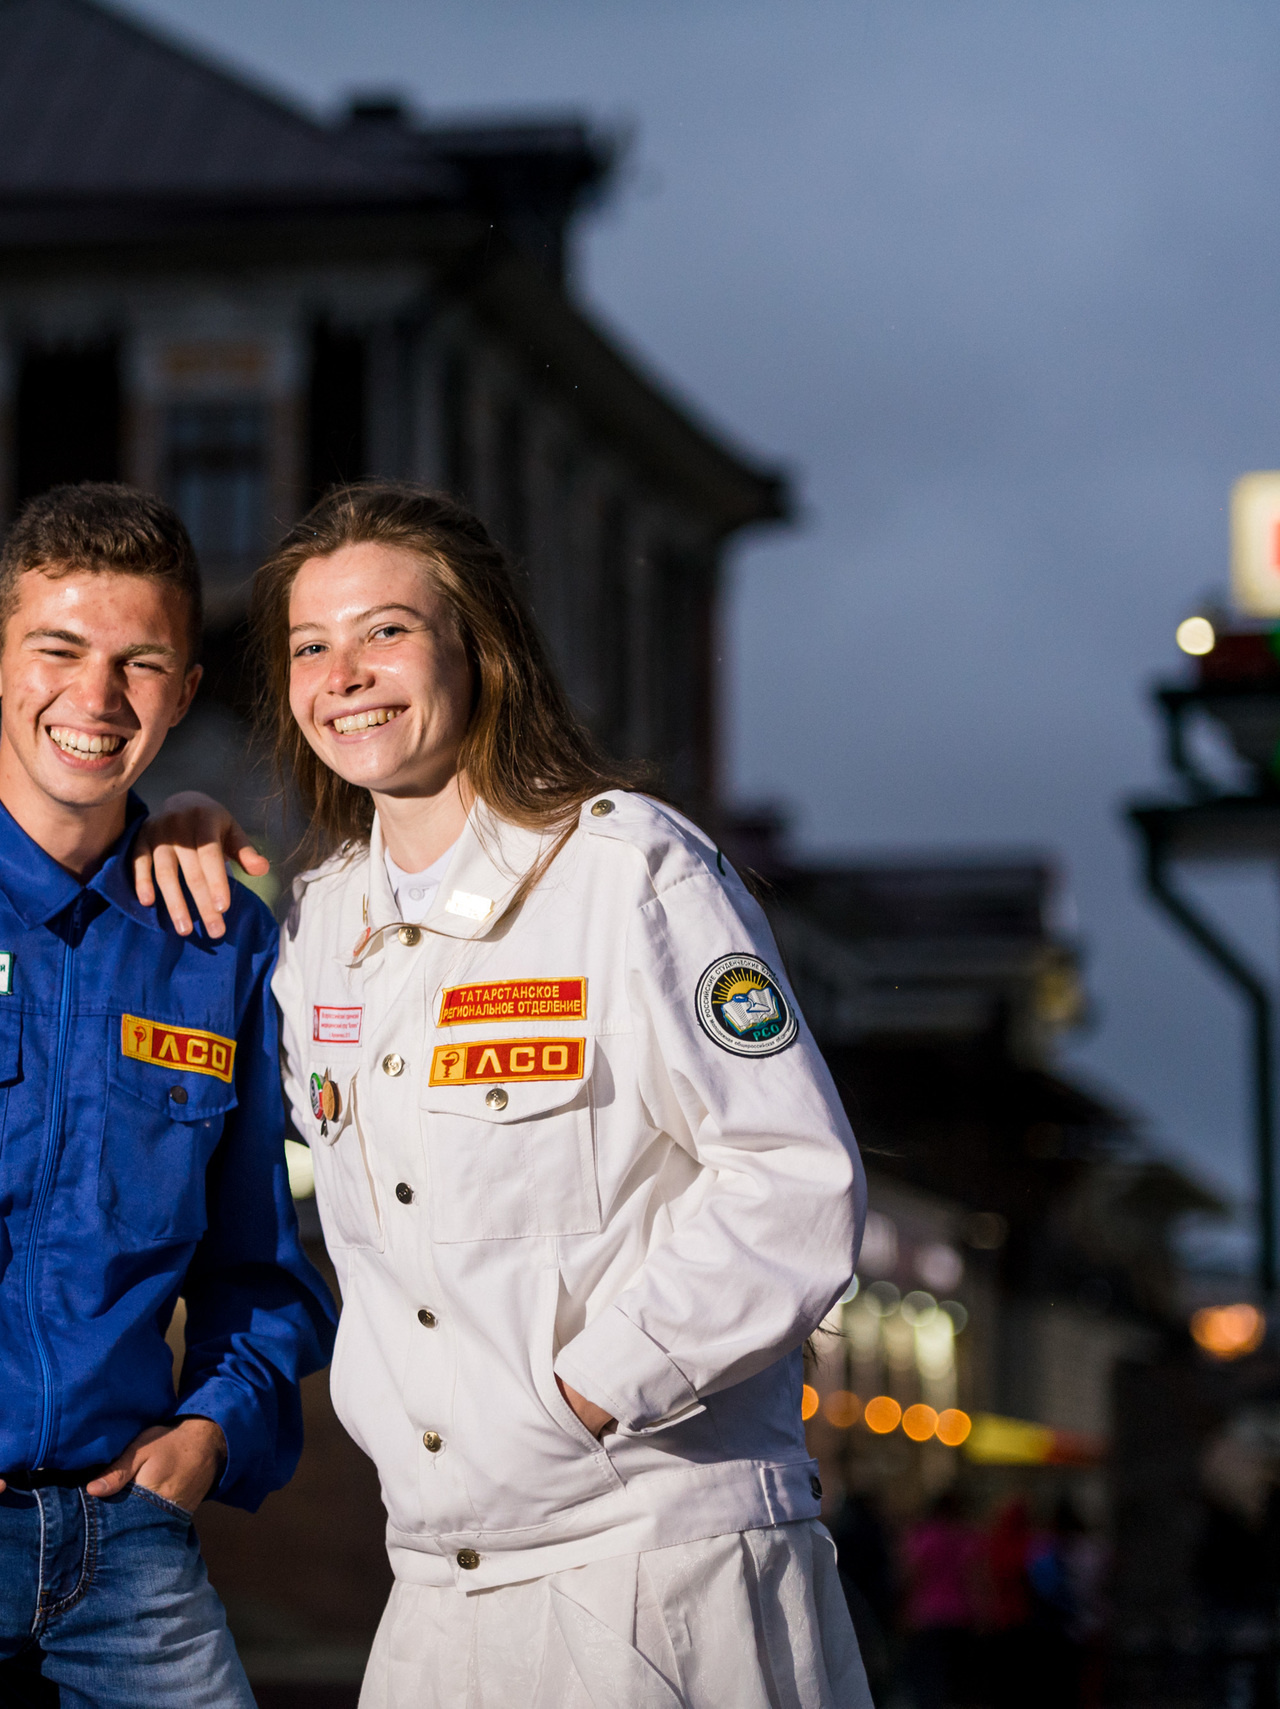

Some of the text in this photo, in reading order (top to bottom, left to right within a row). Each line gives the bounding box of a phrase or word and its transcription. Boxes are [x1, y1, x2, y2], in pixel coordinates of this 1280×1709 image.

[460, 985, 560, 1003] ТАТАРСТАНСКОЕ
[443, 1000, 581, 1019] РЕГИОНАЛЬНОЕ ОТДЕЛЕНИЕ
[753, 1023, 780, 1042] РСО
[158, 1034, 227, 1071] ЛСО
[475, 1045, 569, 1075] ЛСО
